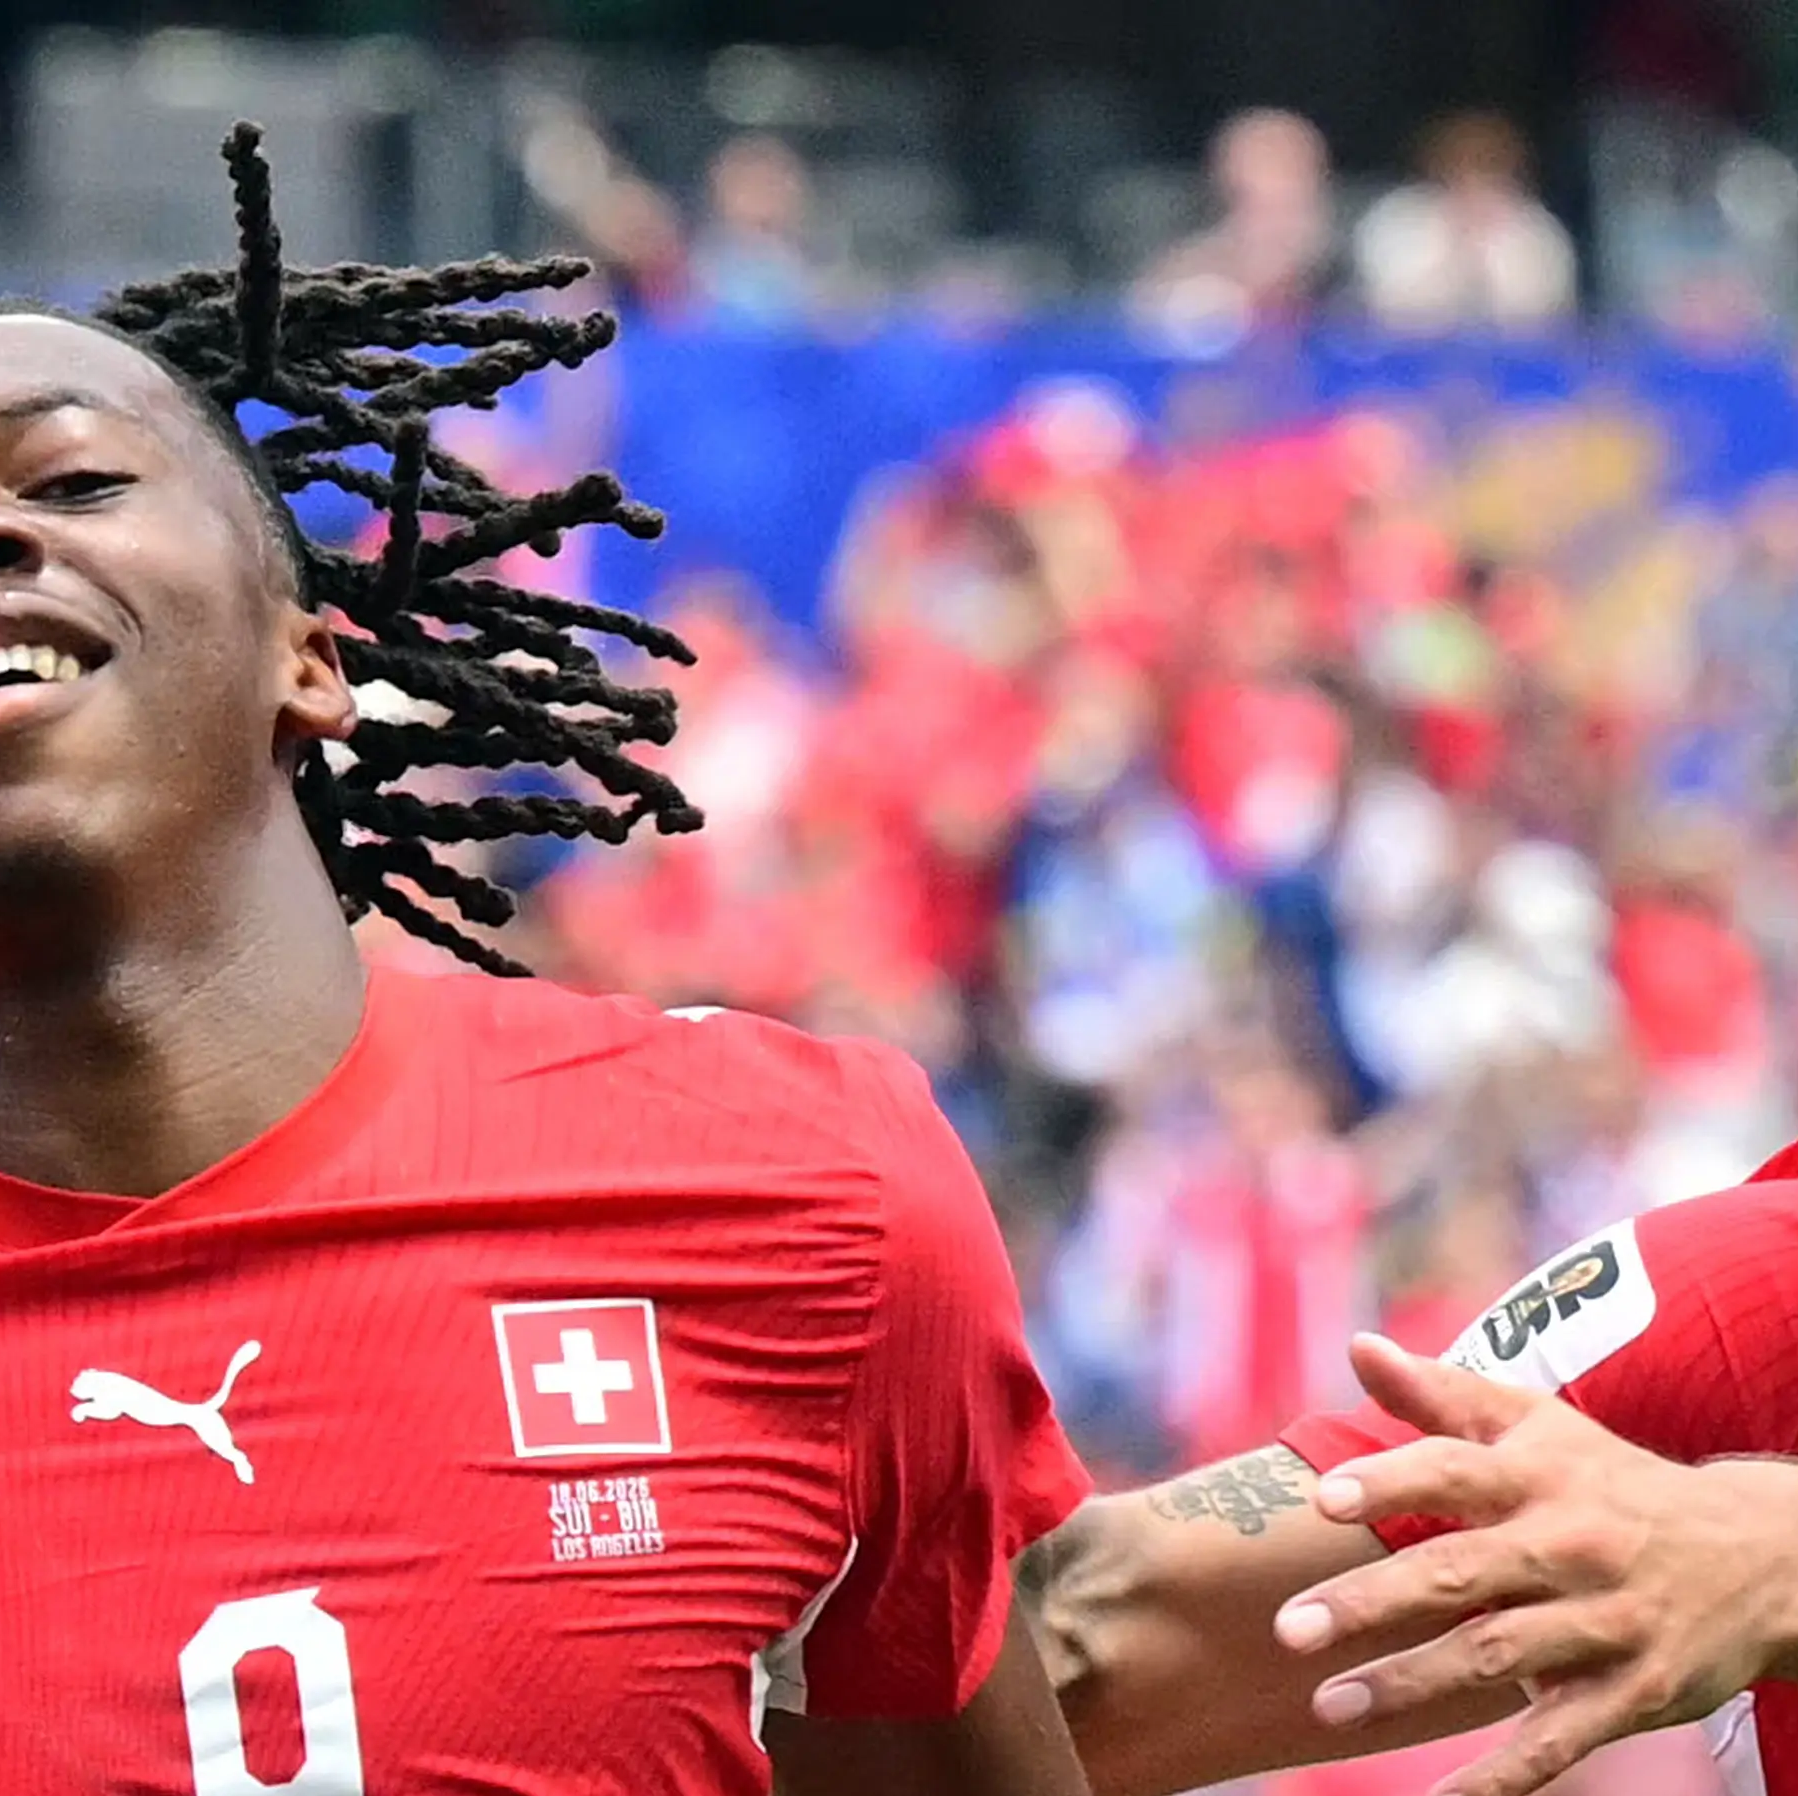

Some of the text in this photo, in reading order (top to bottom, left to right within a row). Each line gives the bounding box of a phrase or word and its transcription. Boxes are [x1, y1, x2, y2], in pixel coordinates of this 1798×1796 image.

[548, 1476, 650, 1505] 18.06.2026
[548, 1498, 593, 1537] SUI
[616, 1498, 659, 1533] BIH
[551, 1531, 665, 1562] LOS ANGELES
